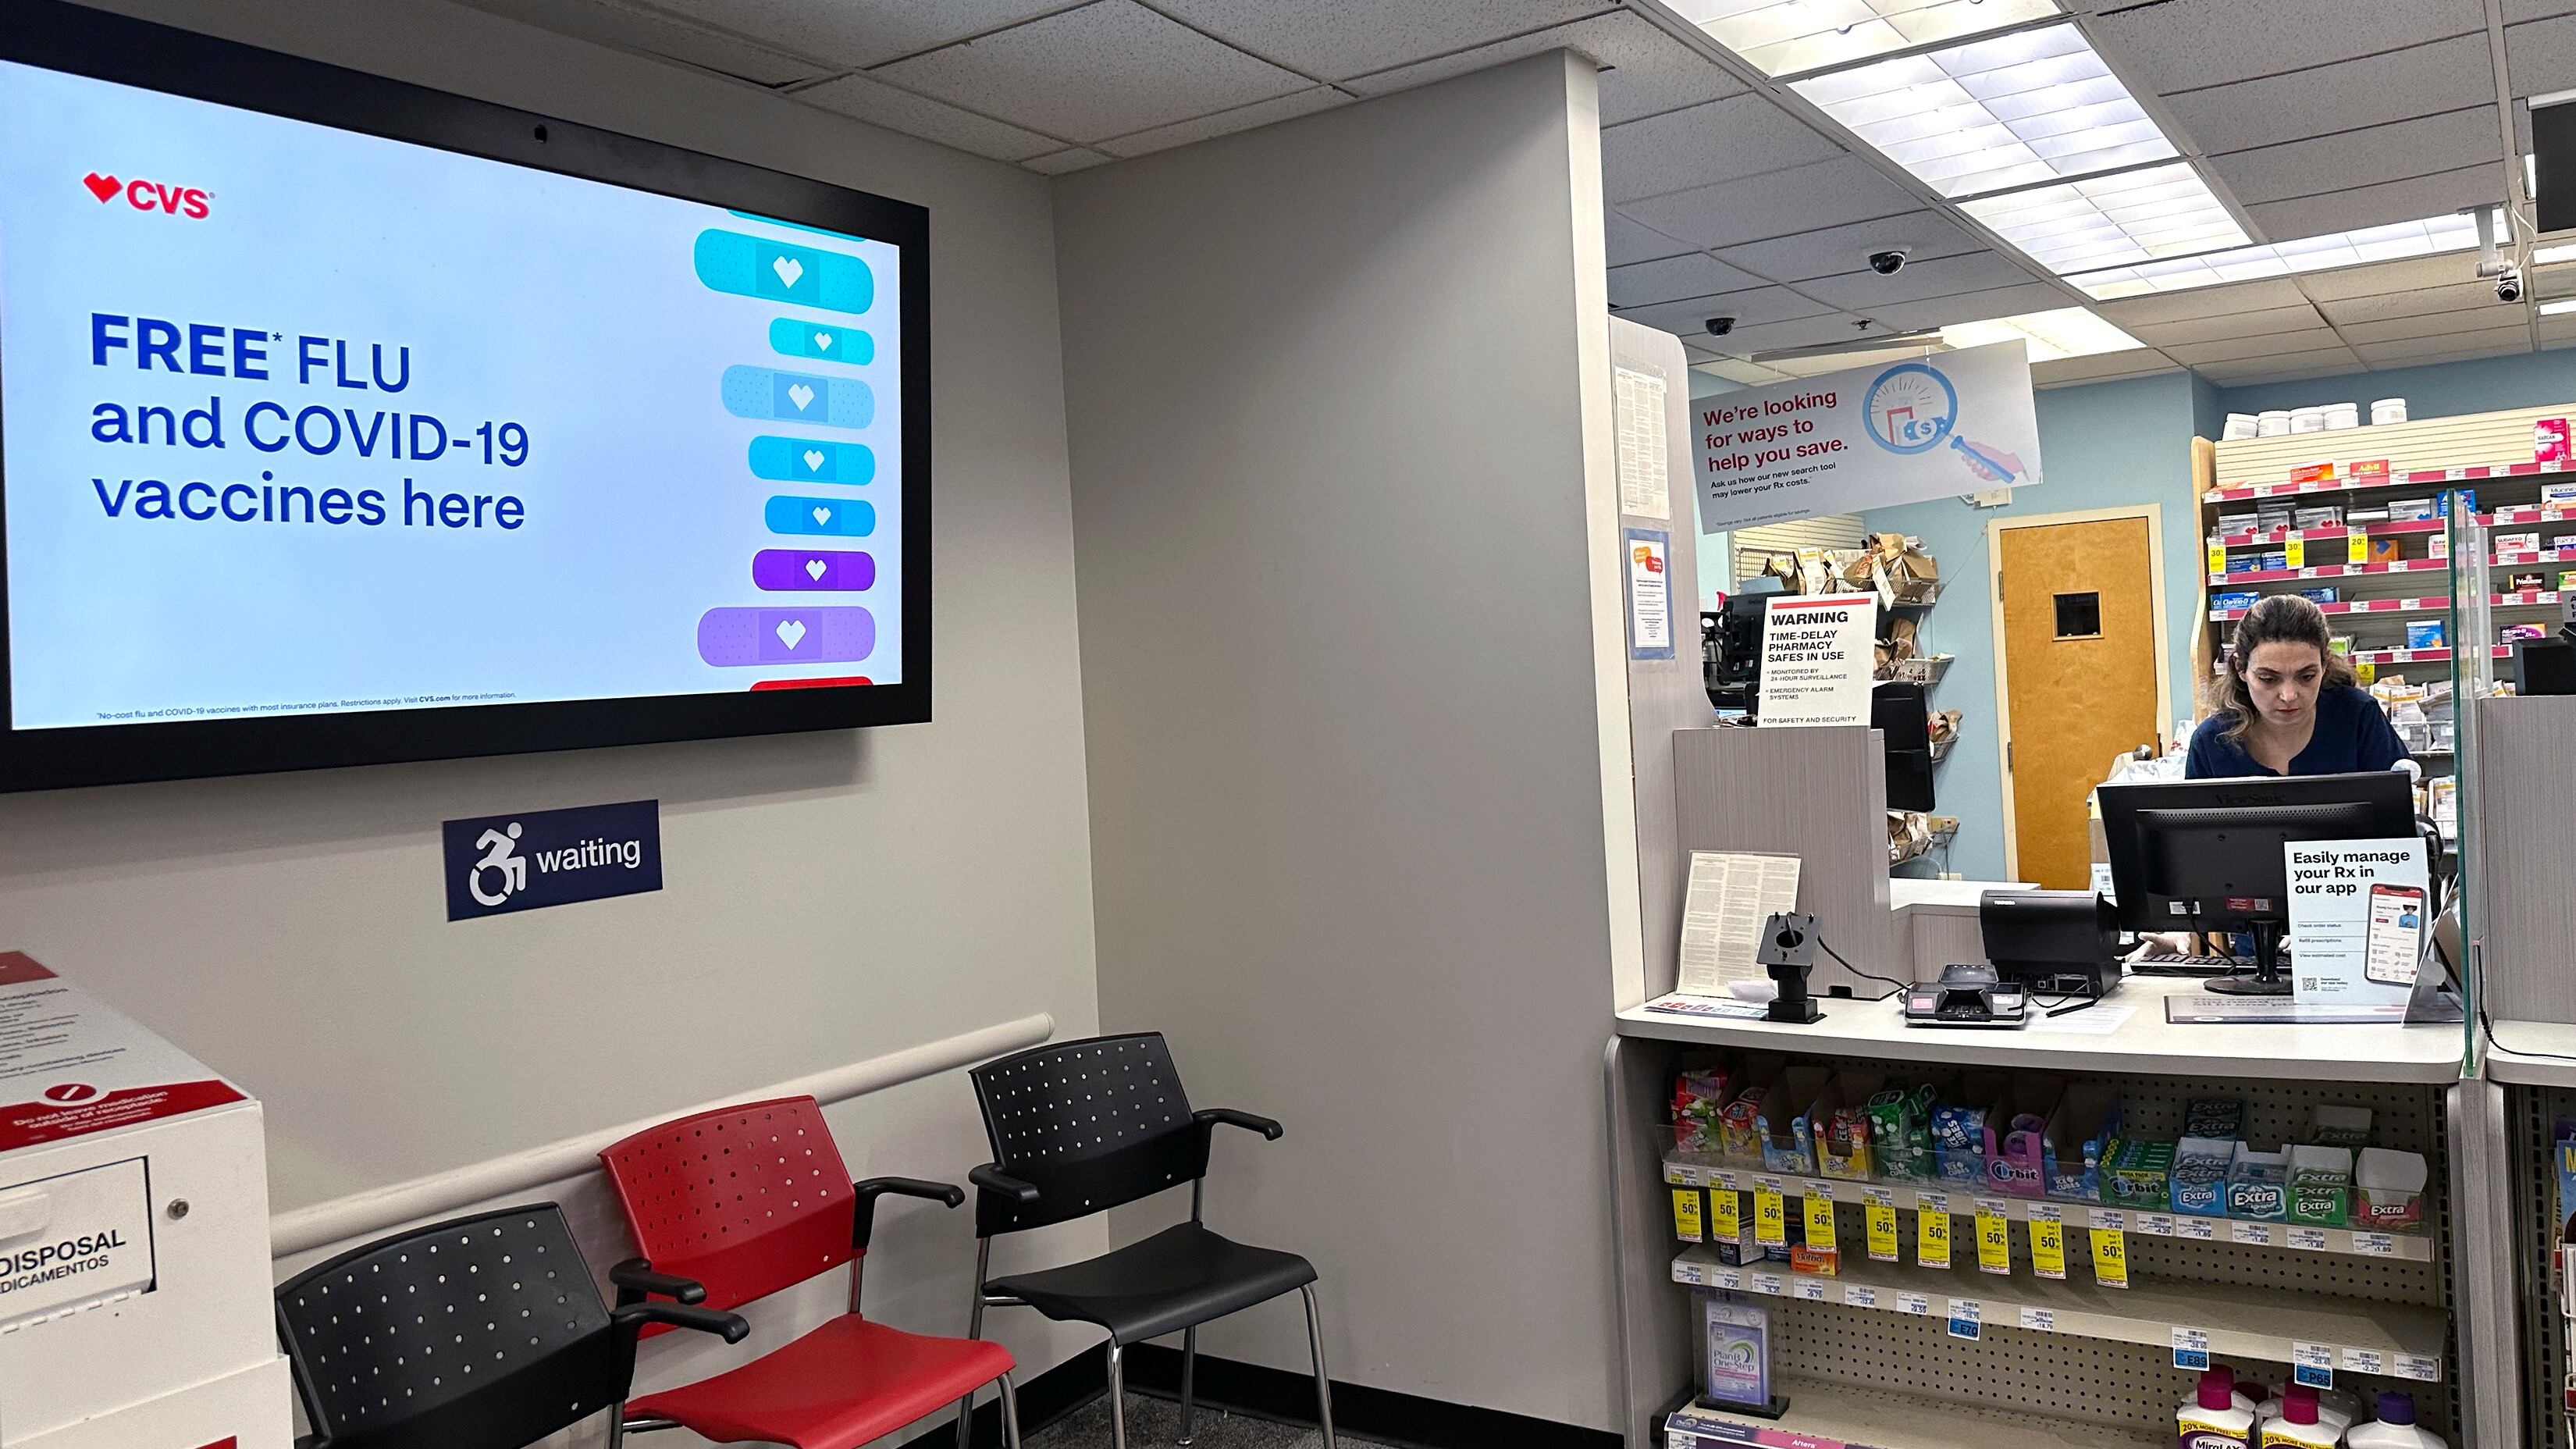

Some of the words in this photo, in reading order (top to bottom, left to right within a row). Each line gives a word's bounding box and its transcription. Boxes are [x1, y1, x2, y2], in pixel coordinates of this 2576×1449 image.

[126, 180, 210, 219] CVS
[298, 336, 411, 393] FLU
[1703, 406, 1758, 426] We're
[1763, 392, 1837, 415] looking
[91, 396, 226, 449] and
[244, 401, 529, 468] COVID-19
[1705, 434, 1732, 450] for
[1738, 425, 1788, 443] ways
[1793, 419, 1813, 434] to
[1708, 454, 1749, 472] help
[1755, 448, 1790, 468] you
[1796, 439, 1848, 457] save.
[1791, 465, 1818, 476] search
[1730, 487, 1752, 497] lower
[1754, 484, 1771, 493] your
[93, 471, 386, 526] vaccines
[404, 479, 525, 530] here
[1771, 611, 1848, 626] WARNING
[1770, 630, 1838, 641] TIME-DELAY
[1769, 642, 1833, 651] PHARMACY
[1768, 653, 1803, 662] SAFES
[1822, 651, 1845, 660] USE
[165, 707, 205, 716] COVID-19
[281, 701, 316, 710] insurance
[318, 700, 338, 709] plans.
[340, 698, 381, 707] Restrictions
[535, 838, 640, 874] waiting
[2293, 851, 2340, 865] Easily
[2343, 852, 2411, 864] manage
[2293, 868, 2331, 881] your
[2334, 867, 2356, 878] Rx
[2360, 865, 2375, 878] in
[2295, 885, 2322, 895] our
[2326, 884, 2357, 896] app
[37, 1113, 59, 1121] not
[98, 1091, 169, 1109] medication
[1990, 1160, 2038, 1182] Orbit
[2110, 1176, 2160, 1197] Orbit
[2183, 1191, 2213, 1202] Extra
[2235, 1191, 2277, 1206] Extra
[1683, 1203, 1697, 1214] 50%
[1720, 1204, 1736, 1215] 50%
[1764, 1208, 1781, 1218] 50%
[2300, 1202, 2332, 1212] Extra
[2371, 1205, 2405, 1216] Extra
[1814, 1214, 1831, 1224] 50%
[1877, 1222, 1894, 1232] 50%
[1930, 1227, 1947, 1238] 50%
[1987, 1232, 2005, 1244] 50%
[2041, 1237, 2059, 1248] 50%
[0, 1229, 126, 1278] DISPOSAL
[2103, 1245, 2121, 1257] 50%
[0, 1255, 109, 1295] DICAMENTOS
[1960, 1324, 1978, 1335] E70
[2187, 1355, 2208, 1366] E89
[2309, 1373, 2331, 1385] P65
[2183, 1423, 2198, 1432] 20%
